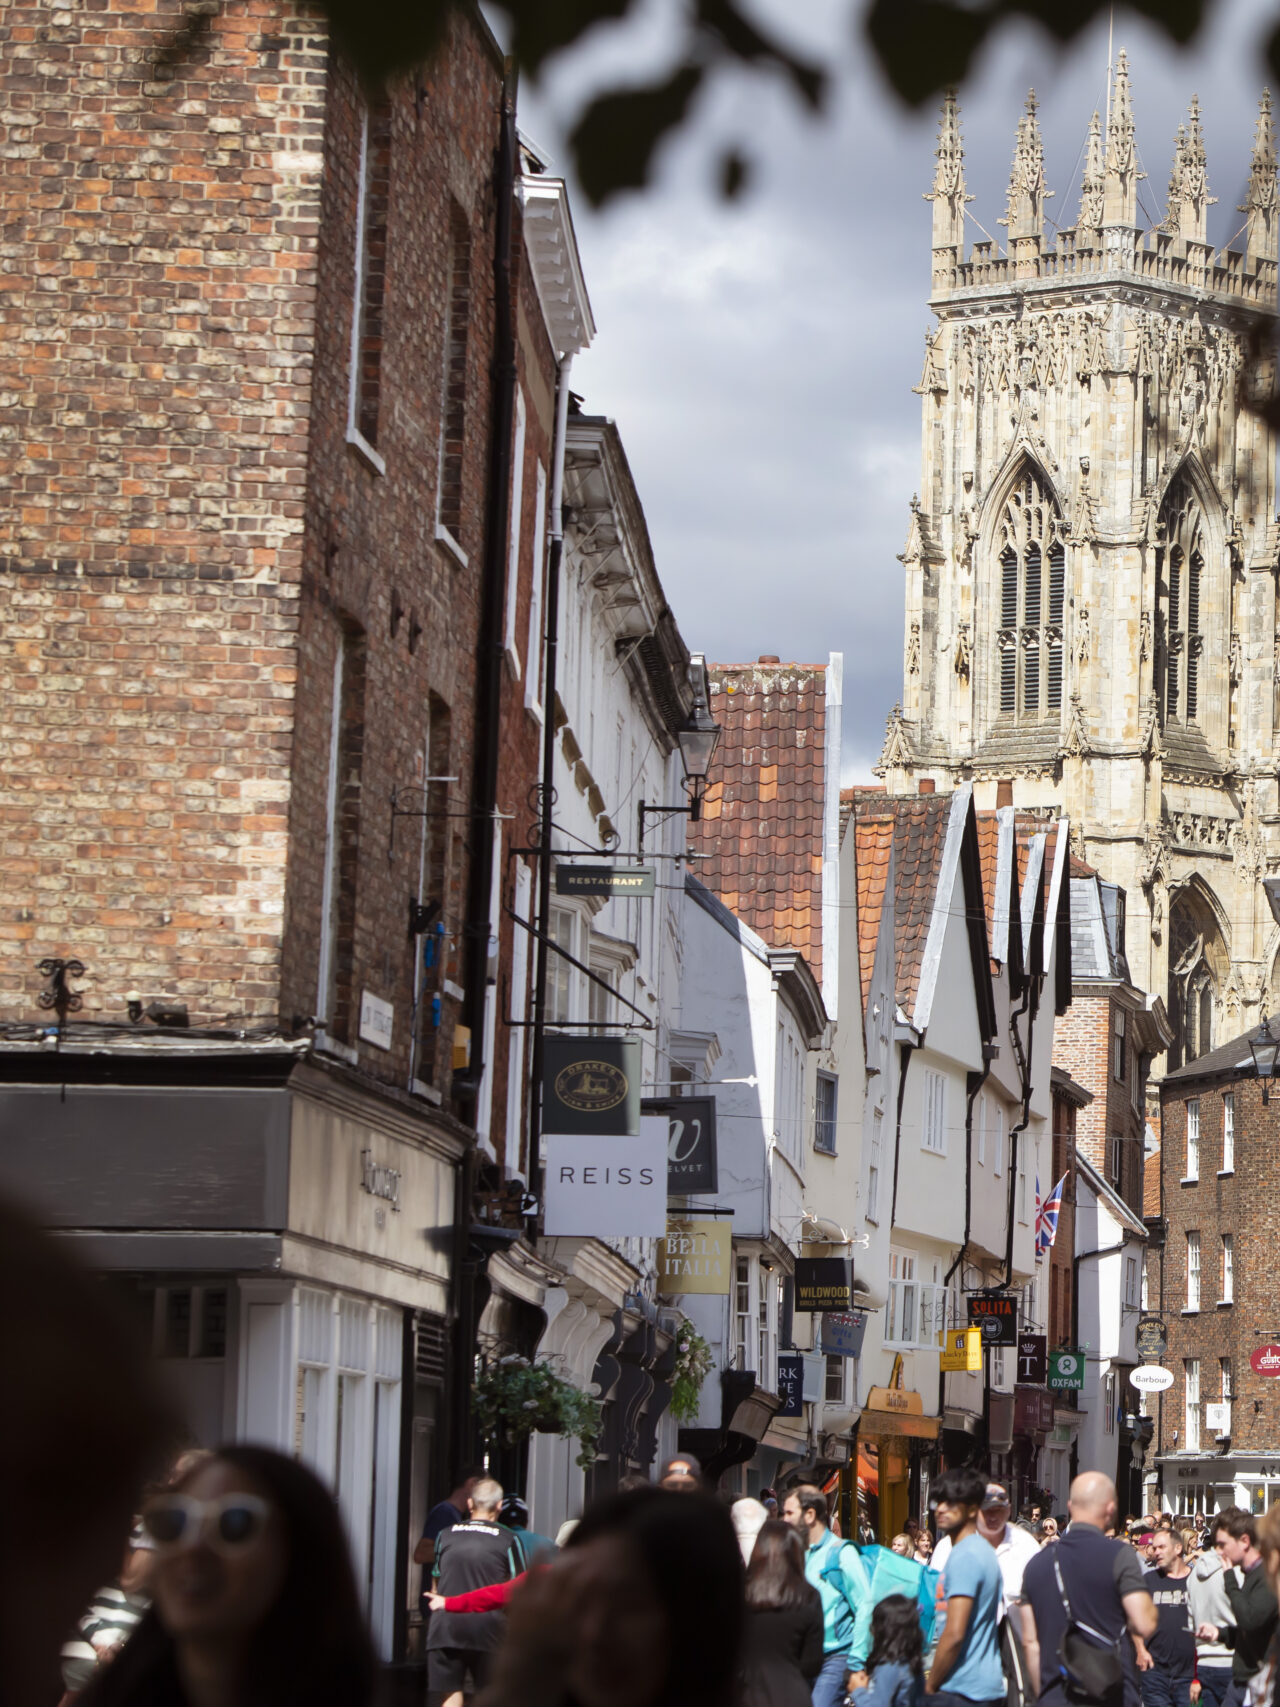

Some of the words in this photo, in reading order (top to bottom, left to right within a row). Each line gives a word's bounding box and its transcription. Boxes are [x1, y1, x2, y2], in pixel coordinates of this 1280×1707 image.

[568, 877, 644, 886] RESTAURANT
[568, 1063, 616, 1076] DRAKE'S
[668, 1164, 704, 1173] ELVET
[560, 1166, 654, 1185] REISS
[667, 1239, 720, 1255] BELLA
[665, 1259, 722, 1276] ITALIA
[800, 1287, 850, 1298] WILDWOOD
[972, 1301, 1012, 1315] SOLITA
[1019, 1356, 1038, 1376] T
[779, 1367, 798, 1379] RK
[1051, 1378, 1082, 1388] OXFAM
[1135, 1375, 1168, 1384] Barbour
